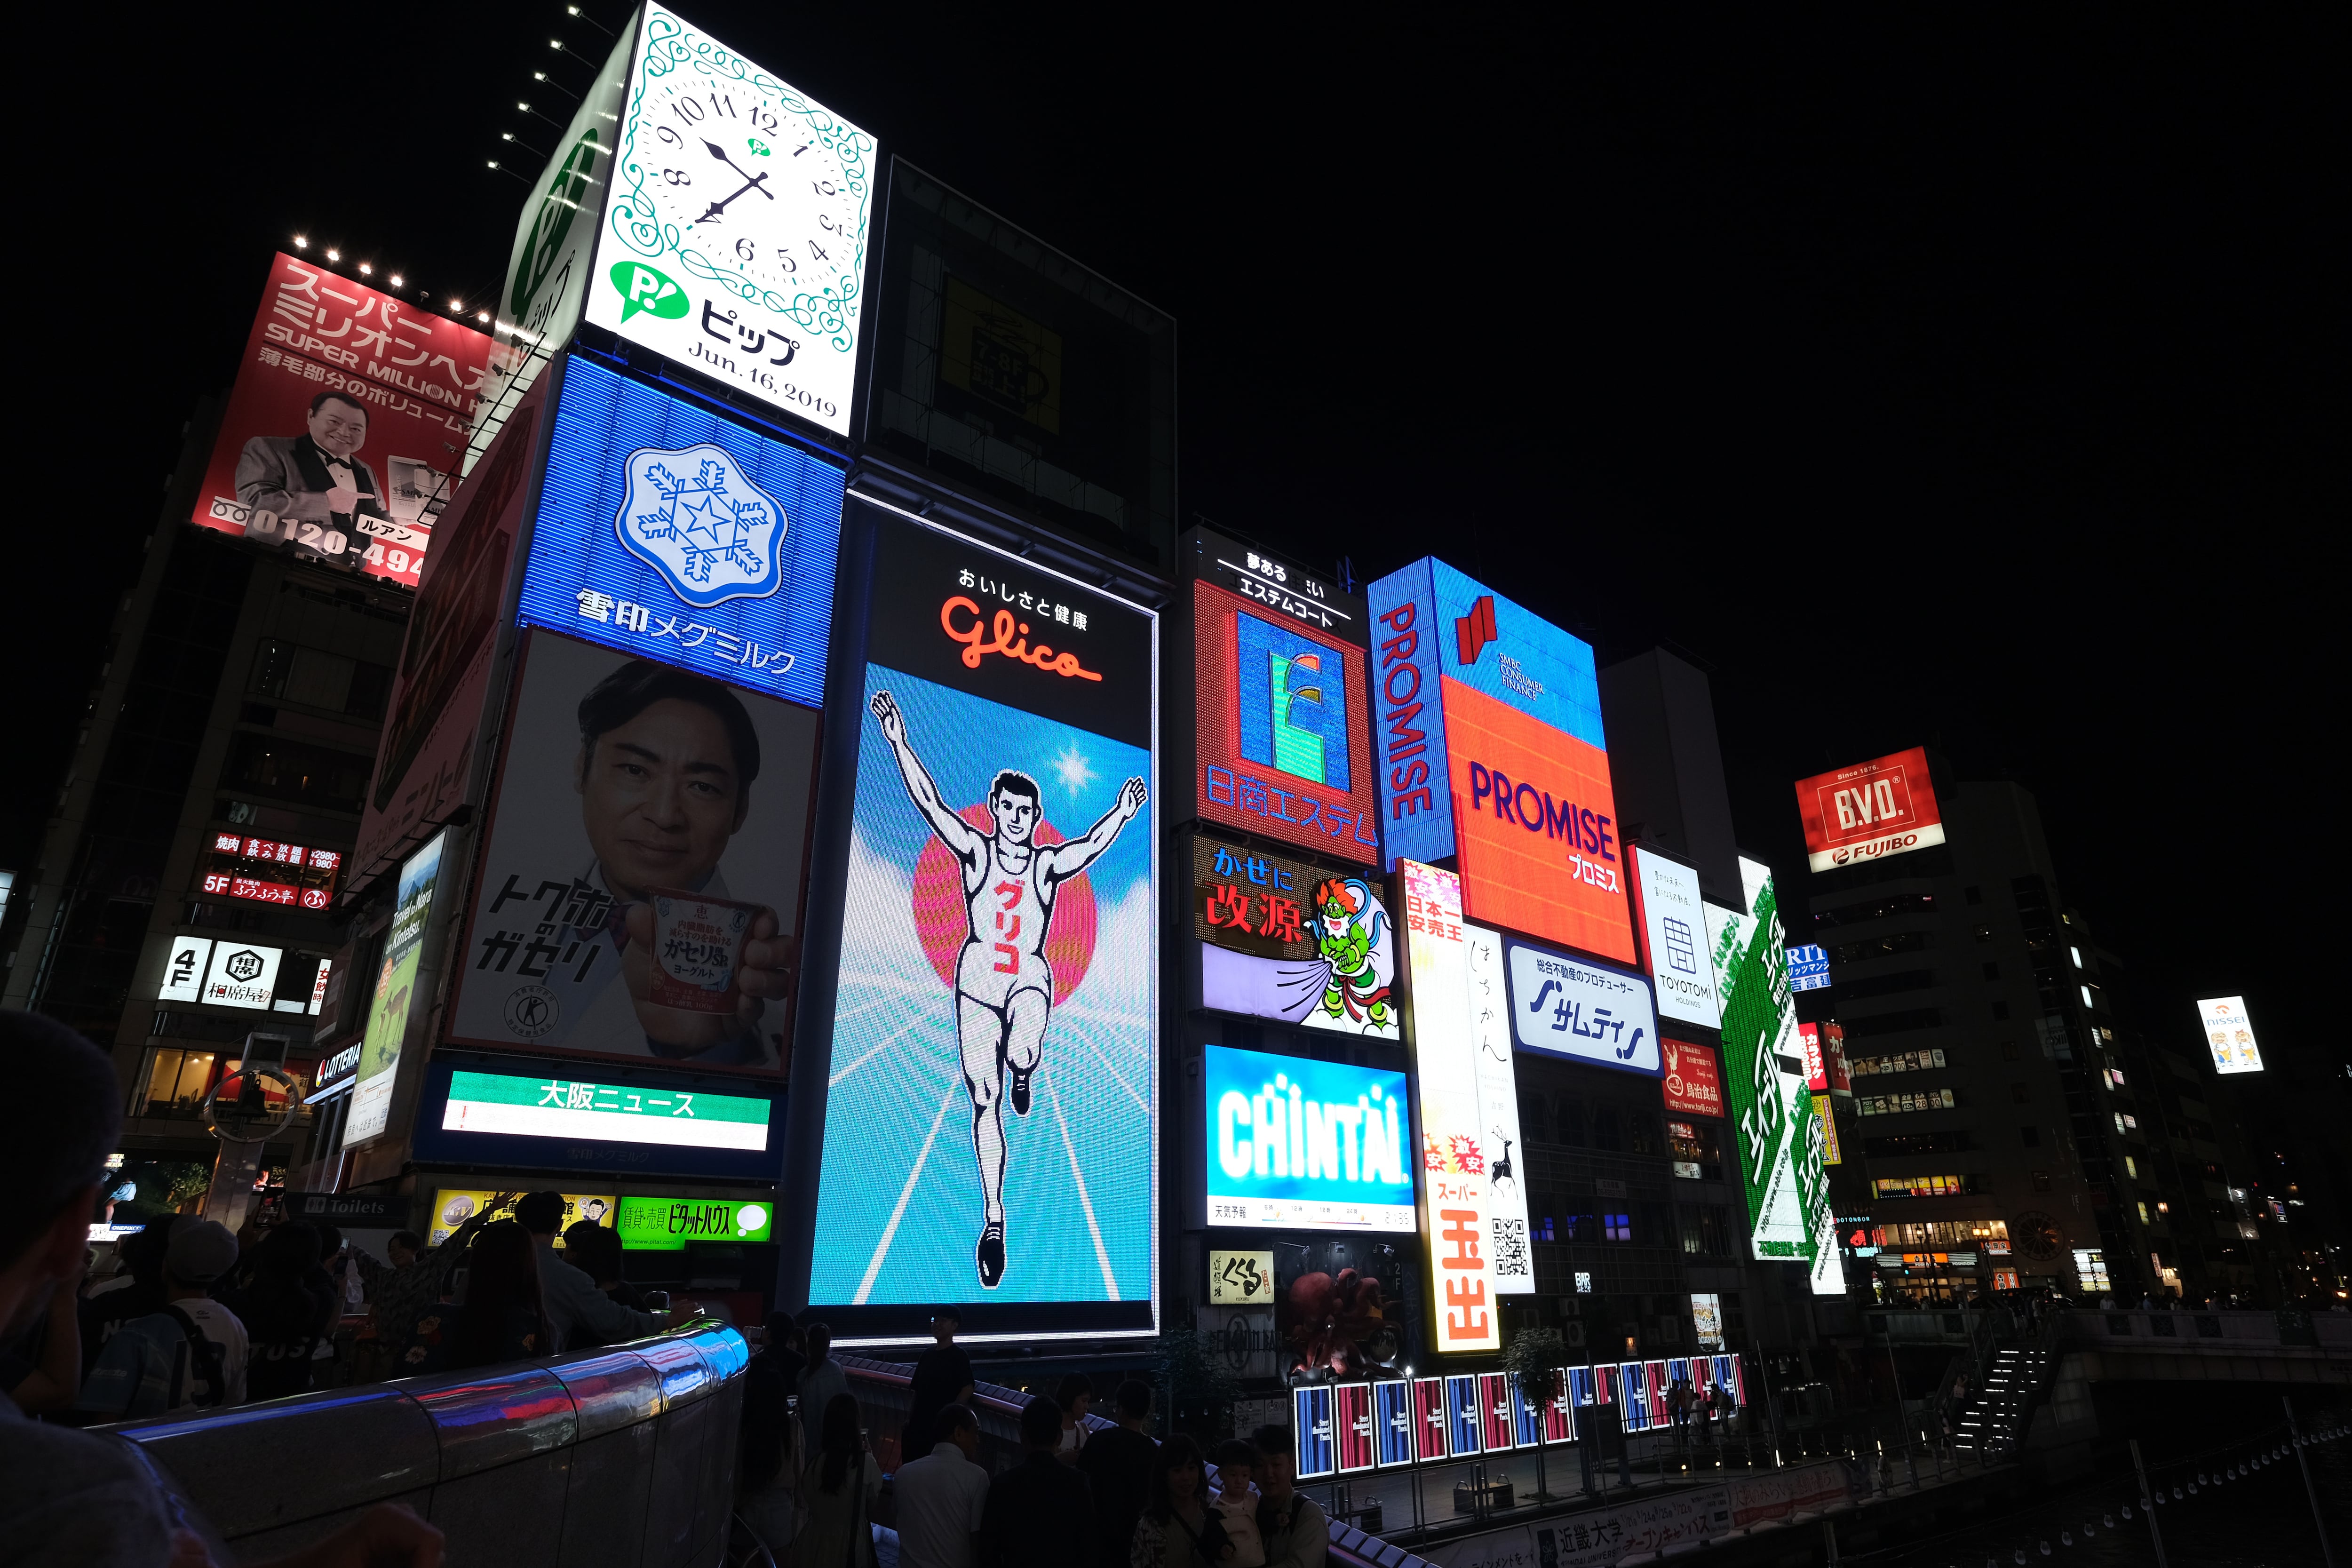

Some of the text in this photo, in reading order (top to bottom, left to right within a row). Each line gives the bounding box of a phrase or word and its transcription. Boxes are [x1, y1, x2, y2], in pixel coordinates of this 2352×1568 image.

[671, 97, 704, 126] 10
[709, 93, 737, 118] 11
[749, 106, 778, 136] 12
[657, 127, 683, 149] 9
[793, 144, 809, 157] 1
[664, 169, 691, 186] 8
[813, 181, 836, 196] 2
[820, 215, 842, 236] 3
[736, 238, 754, 261] 6
[778, 249, 796, 273] 5
[809, 240, 829, 262] 4
[280, 264, 432, 334] スーパー
[701, 299, 800, 366] ピップ
[265, 323, 462, 407] SUPER MILLION
[689, 342, 836, 418] Jun. 16, 2019
[361, 519, 412, 542] ルアン
[959, 568, 1087, 631] おいしさと健康
[1240, 578, 1332, 628] エステムコート
[576, 588, 795, 675] 雪印メグミルク
[941, 596, 1102, 682] Glico
[1500, 652, 1522, 672] SMBC
[1500, 663, 1544, 694] CONSUMER
[1502, 677, 1537, 701] FINANCE
[1379, 602, 1431, 820] PROMISE
[1837, 764, 1879, 780] Since 1876.
[1208, 764, 1379, 845] 日商エステム
[1471, 761, 1615, 862] PROMISE
[1834, 779, 1905, 830] B.V.D.
[216, 836, 240, 851] 焼肉
[247, 848, 301, 864] 飲み放題
[248, 839, 303, 855] 食べ放題
[1853, 834, 1917, 859] FUJIBO
[204, 876, 230, 892] 5F
[1213, 848, 1293, 891] かぜに
[1569, 854, 1620, 894] プロミス
[234, 885, 294, 904] ふうふう亭
[392, 904, 411, 930] Travel
[416, 888, 432, 912] Nara
[489, 874, 614, 929] トクホ
[1407, 895, 1460, 918] 日本一
[993, 879, 1025, 975] グリコ
[1206, 883, 1303, 942] 改源
[1407, 915, 1463, 942] 安売王
[477, 931, 601, 982] ガセリ
[1762, 910, 1785, 991] エイブル
[171, 950, 196, 987] 4F
[674, 965, 715, 979] ヨーグルト
[1537, 958, 1634, 994] 総合不動産のプロデューサー
[207, 982, 264, 1003] 相席屋
[1676, 996, 1701, 1008] HOLDINGS
[324, 1042, 361, 1080] LOTTERIA
[1807, 1034, 1824, 1079] カラオケ
[538, 1080, 695, 1117] 大阪ニュース
[1686, 1082, 1718, 1102] 鳥治食品
[1741, 1028, 1781, 1186] エイブル
[1798, 1111, 1823, 1209] エイブル
[331, 1198, 385, 1215] Toilets
[1438, 1183, 1478, 1201] スーパー
[622, 1203, 730, 1235] 賃貸・売買 ピタットハウス
[1215, 1205, 1246, 1218] 天気予報
[1222, 1258, 1262, 1296] くくる
[1440, 1209, 1489, 1340] 玉出
[1575, 1273, 1591, 1286] BAR
[1559, 1518, 1623, 1554] 近畿大学
